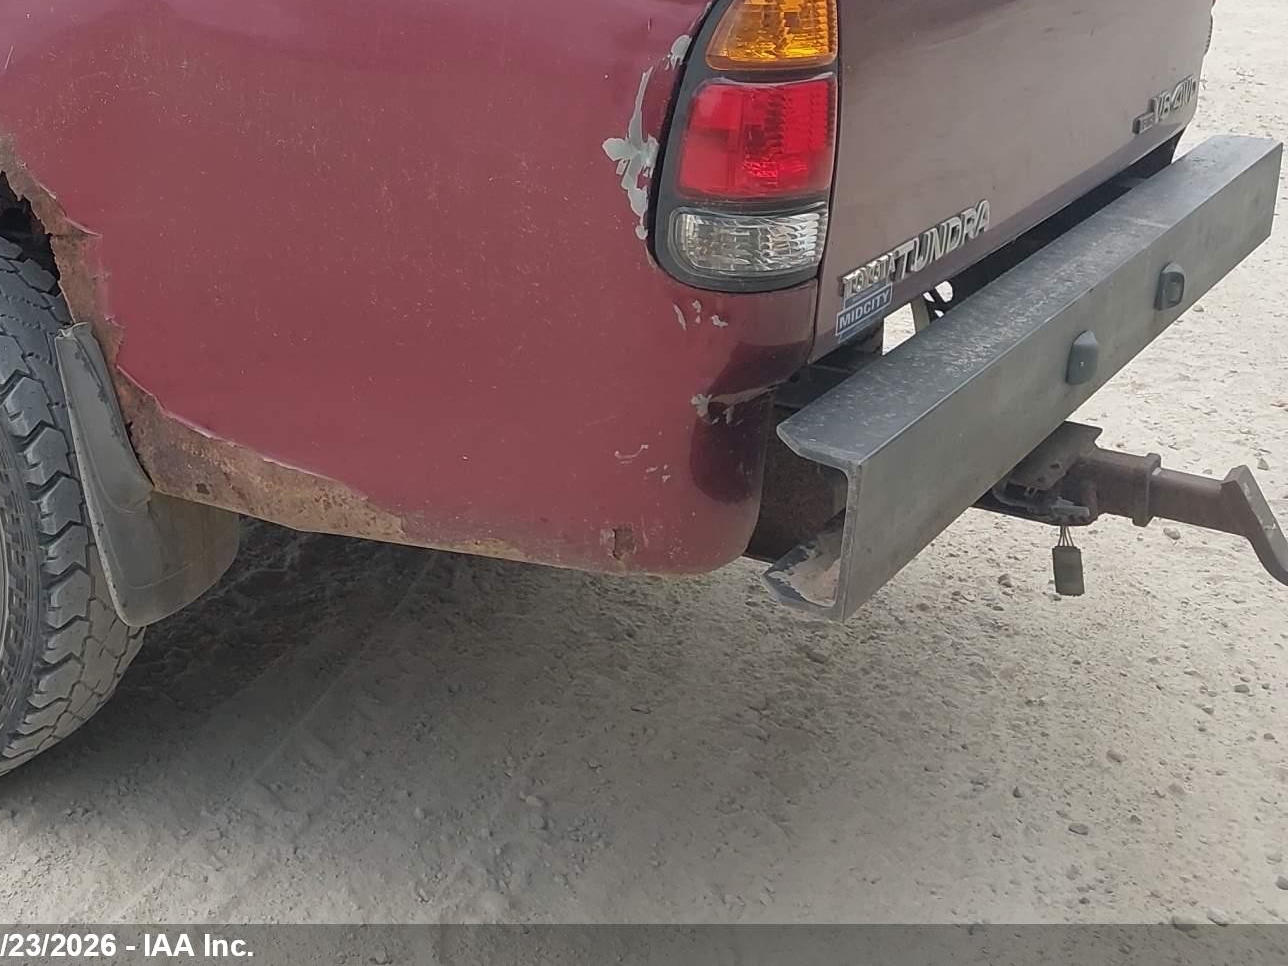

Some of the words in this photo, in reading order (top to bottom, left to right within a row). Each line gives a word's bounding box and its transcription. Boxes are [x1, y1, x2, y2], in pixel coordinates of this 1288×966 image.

[842, 252, 896, 298] TOYOTA
[894, 199, 991, 281] TUNDRA
[839, 292, 890, 330] MIDCITY
